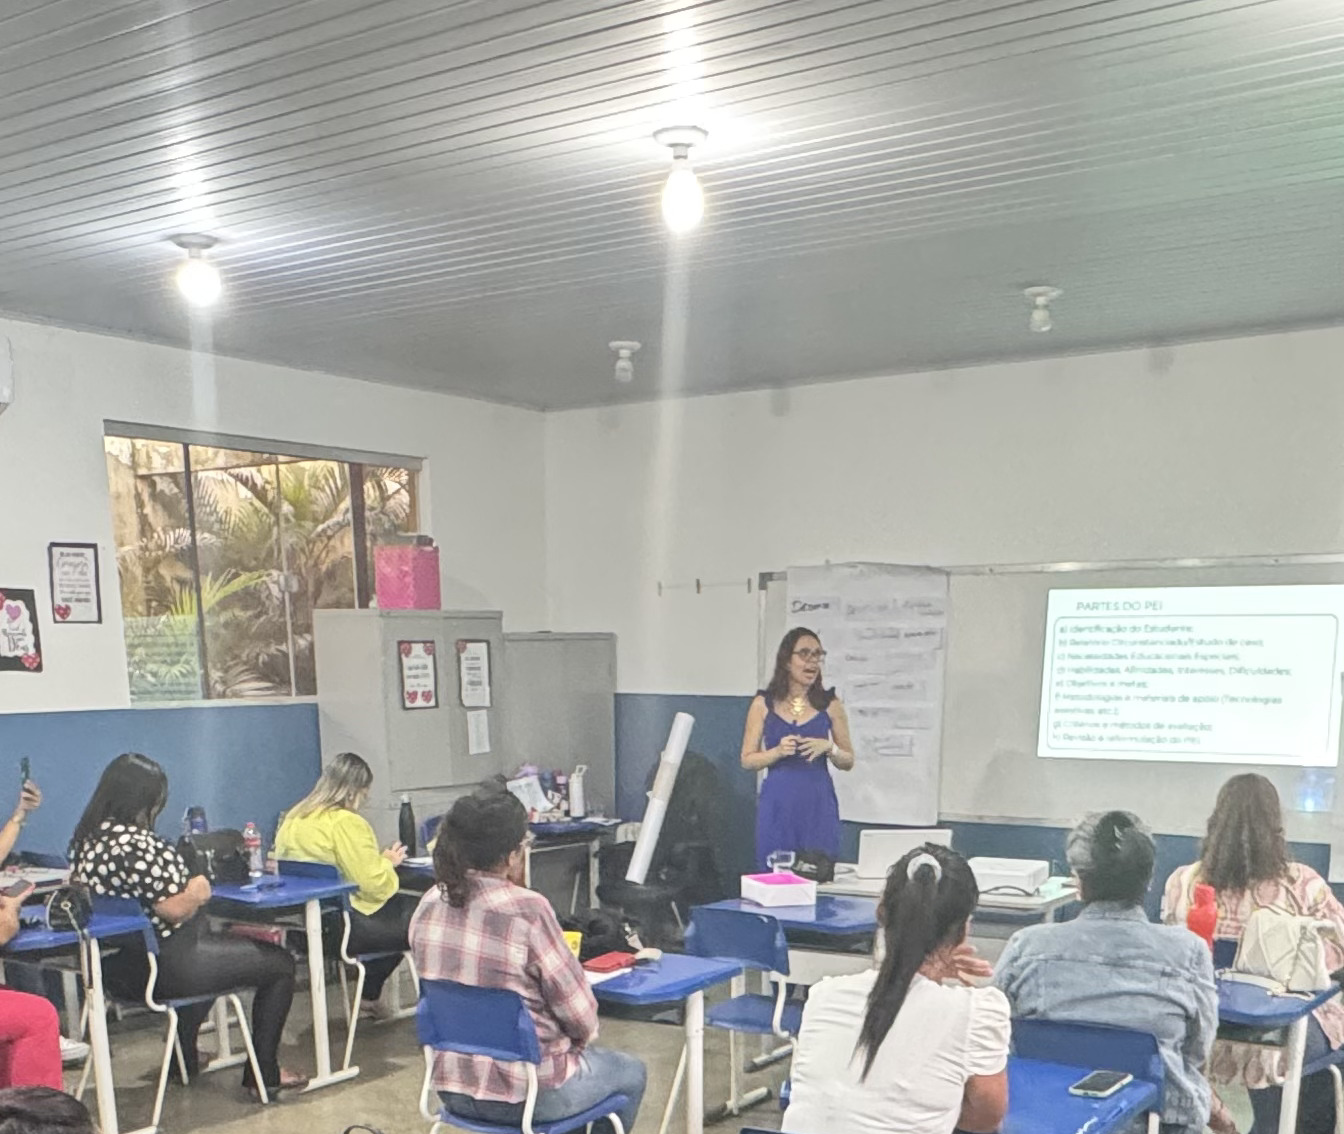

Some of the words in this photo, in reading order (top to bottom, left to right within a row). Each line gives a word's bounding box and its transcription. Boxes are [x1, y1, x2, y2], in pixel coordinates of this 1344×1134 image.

[1076, 601, 1119, 611] PARTES
[1122, 601, 1141, 610] DO
[1144, 600, 1163, 610] PEI
